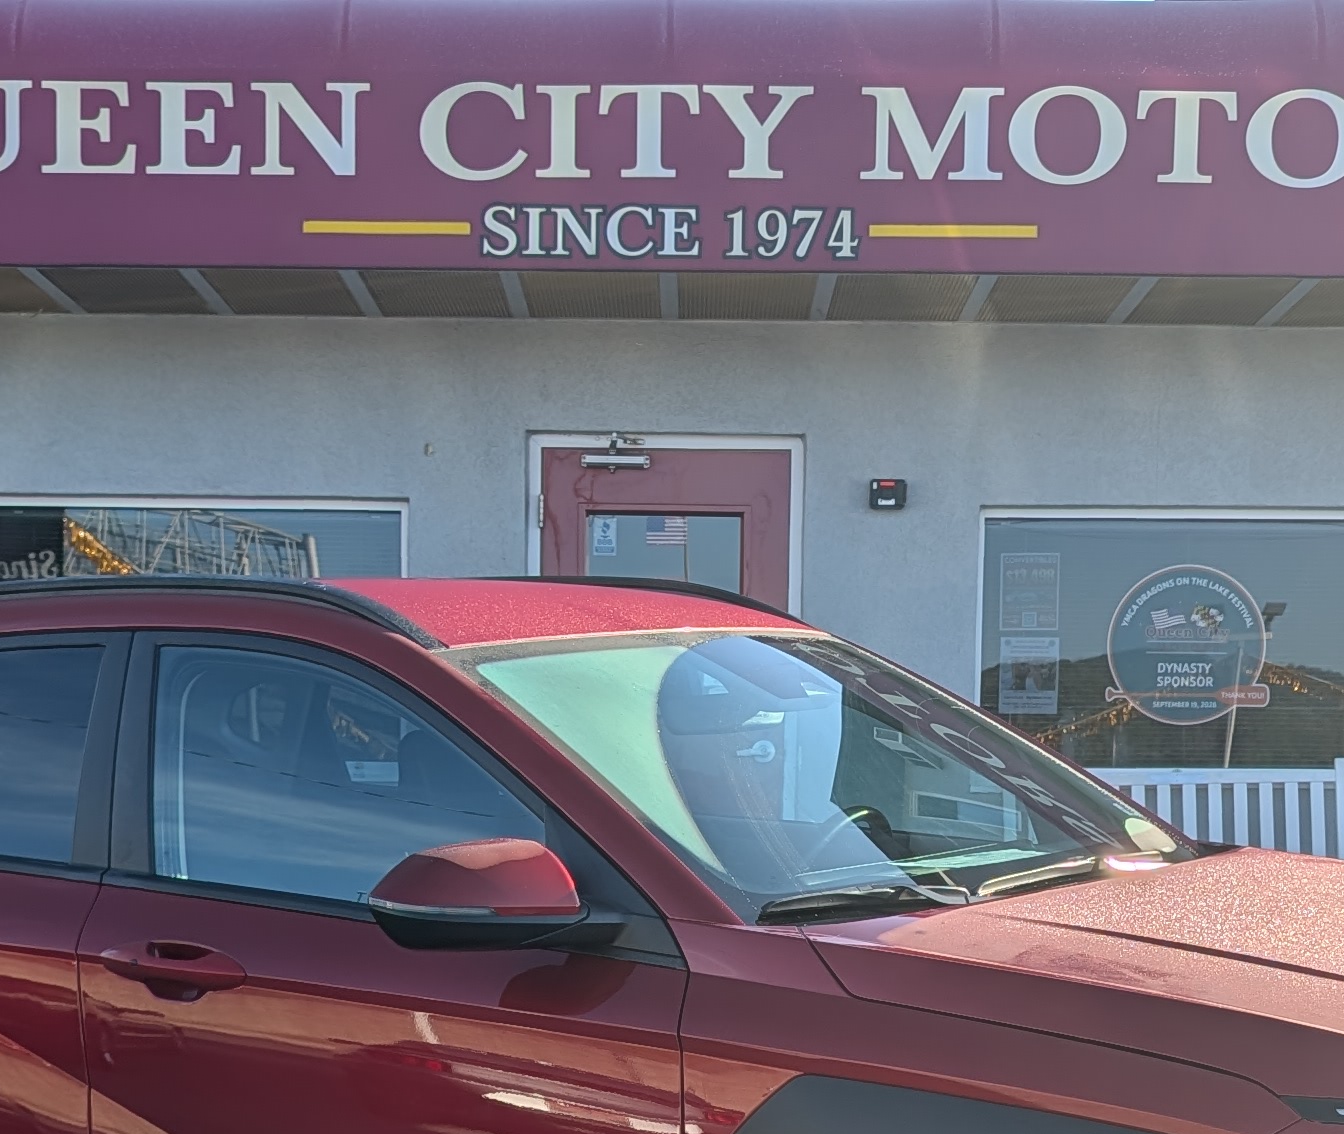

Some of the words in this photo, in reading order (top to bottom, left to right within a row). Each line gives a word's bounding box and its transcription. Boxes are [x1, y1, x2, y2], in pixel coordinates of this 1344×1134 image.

[418, 81, 815, 181] CITY
[481, 205, 700, 258] SINCE
[724, 208, 859, 258] 1974
[1121, 605, 1139, 627] YMCA
[1136, 579, 1175, 606] DRAGONS
[1175, 577, 1190, 586] ON
[1191, 576, 1209, 587] THE
[1208, 580, 1230, 597] LAKE
[1227, 593, 1254, 629] FESTIVAL
[1156, 676, 1213, 688] SPONSOR
[1157, 662, 1213, 675] DYNASTY
[1152, 700, 1190, 708] SEPTEMBER
